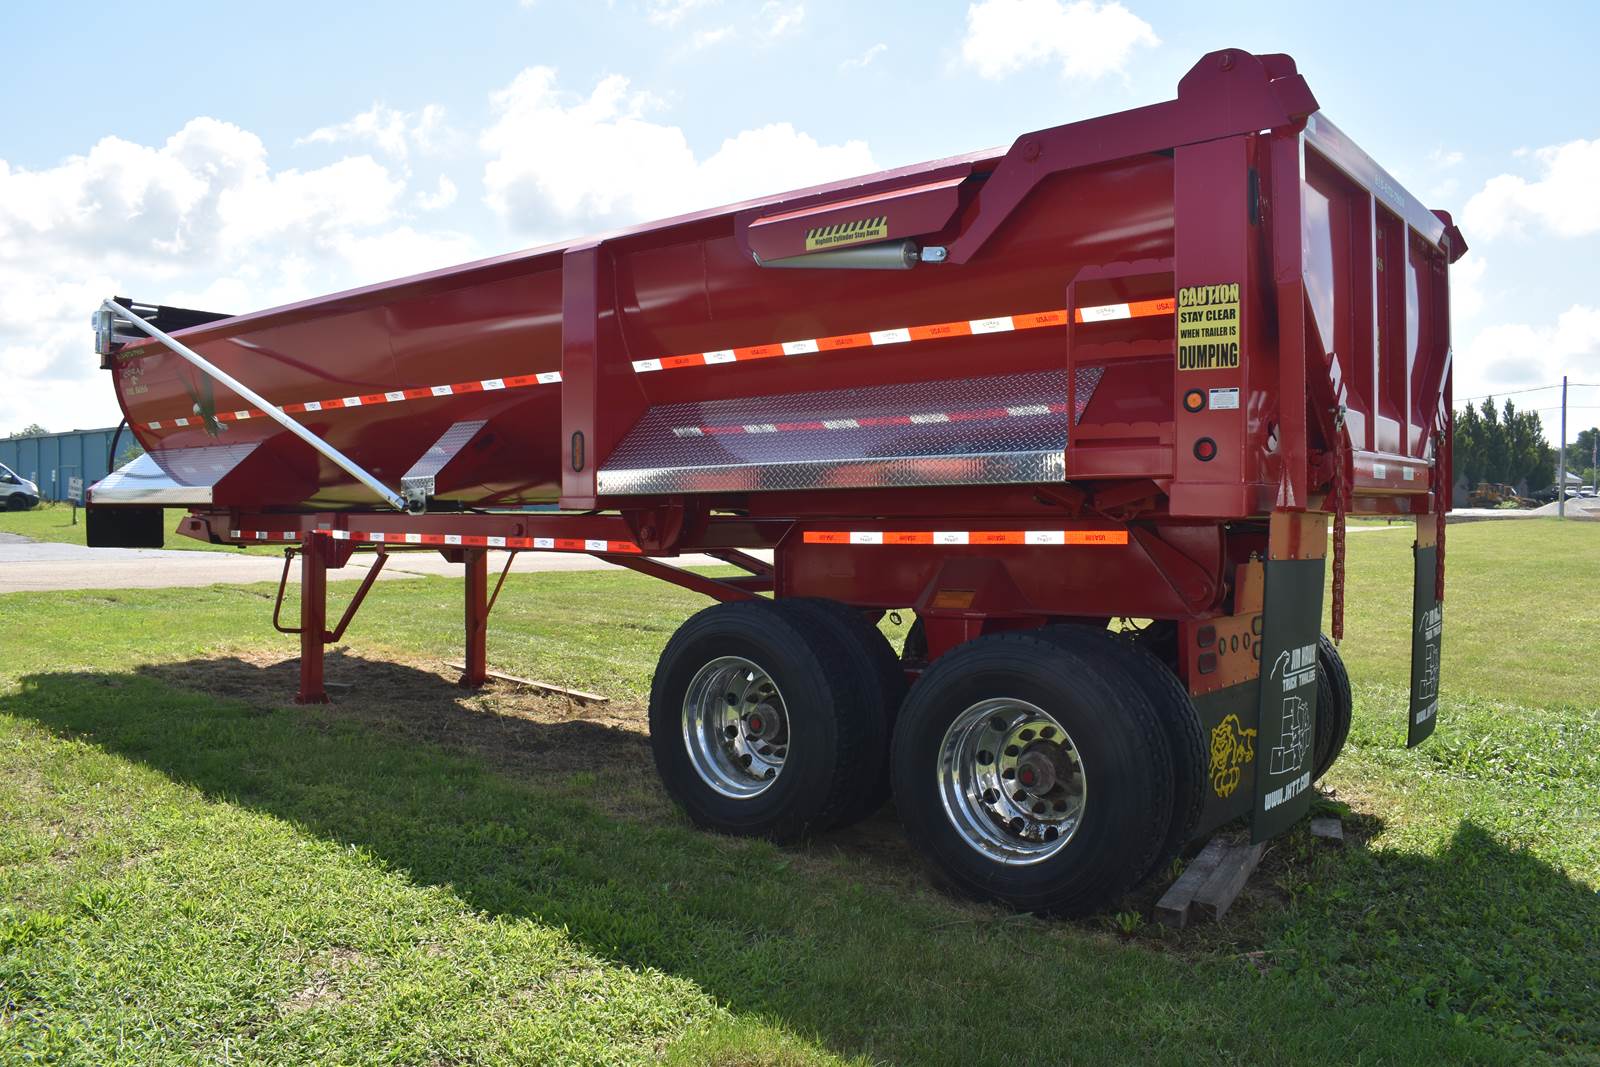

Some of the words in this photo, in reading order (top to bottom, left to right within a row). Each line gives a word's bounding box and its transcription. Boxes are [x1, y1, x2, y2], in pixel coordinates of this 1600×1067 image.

[1178, 283, 1239, 306] CAUTION
[1180, 311, 1203, 323] STAY
[1206, 308, 1236, 321] CLEAR
[1180, 328, 1200, 339] WHEN
[1201, 326, 1228, 338] TRAILER
[1229, 326, 1237, 336] IS
[1179, 342, 1238, 369] DUMPING
